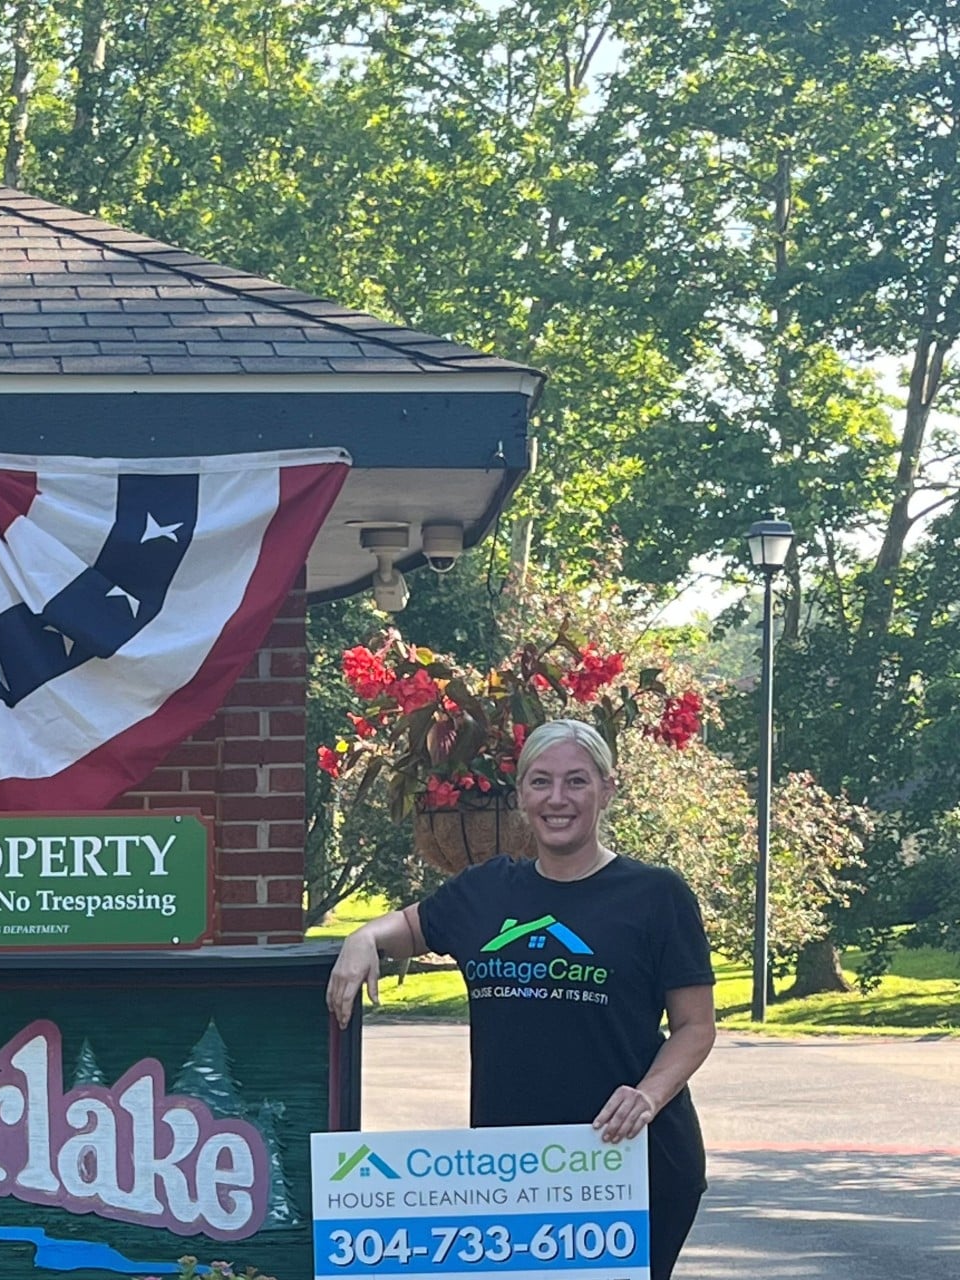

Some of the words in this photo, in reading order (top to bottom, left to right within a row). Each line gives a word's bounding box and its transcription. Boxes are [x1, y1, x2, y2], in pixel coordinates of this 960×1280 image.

[36, 888, 177, 917] Trespassing
[3, 924, 70, 934] DEPARTMENT
[465, 957, 608, 984] CottageCare
[494, 986, 548, 999] CLEANING
[550, 988, 564, 999] AT
[566, 989, 580, 1001] ITS
[406, 1143, 623, 1183] CottageCare
[328, 1191, 395, 1209] HOUSE
[403, 1188, 508, 1208] CLEANING
[516, 1187, 540, 1204] AT
[547, 1185, 573, 1203] ITS
[581, 1183, 633, 1202] BEST!
[328, 1220, 636, 1268] 304-733-6100
